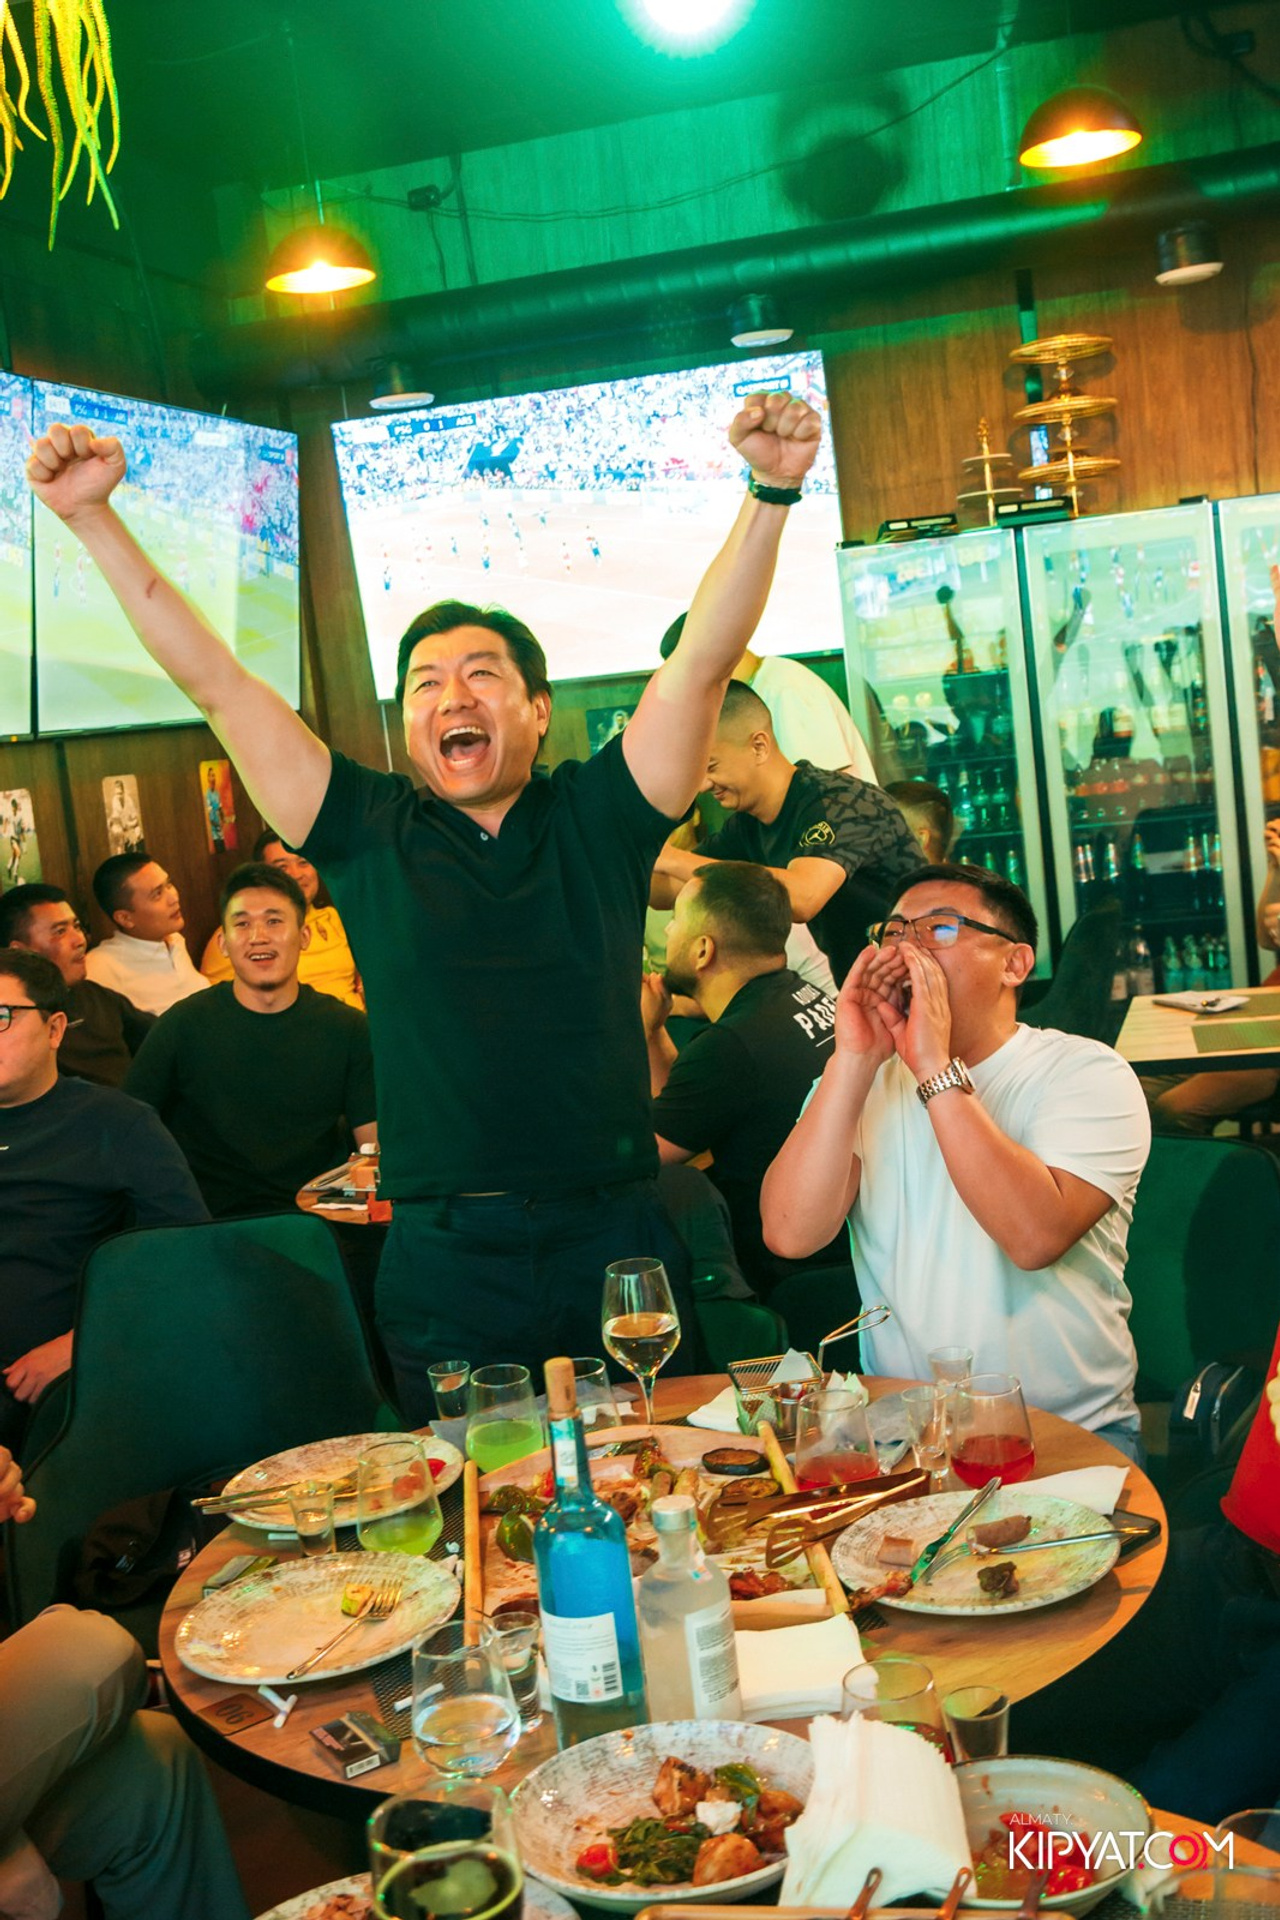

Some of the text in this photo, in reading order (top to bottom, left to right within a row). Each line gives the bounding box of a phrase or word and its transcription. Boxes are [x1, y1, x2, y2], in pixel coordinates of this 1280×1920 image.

[74, 404, 88, 416] PSG
[103, 410, 108, 419] 1
[394, 424, 413, 436] PSG
[423, 422, 431, 431] 0
[438, 420, 444, 430] 1
